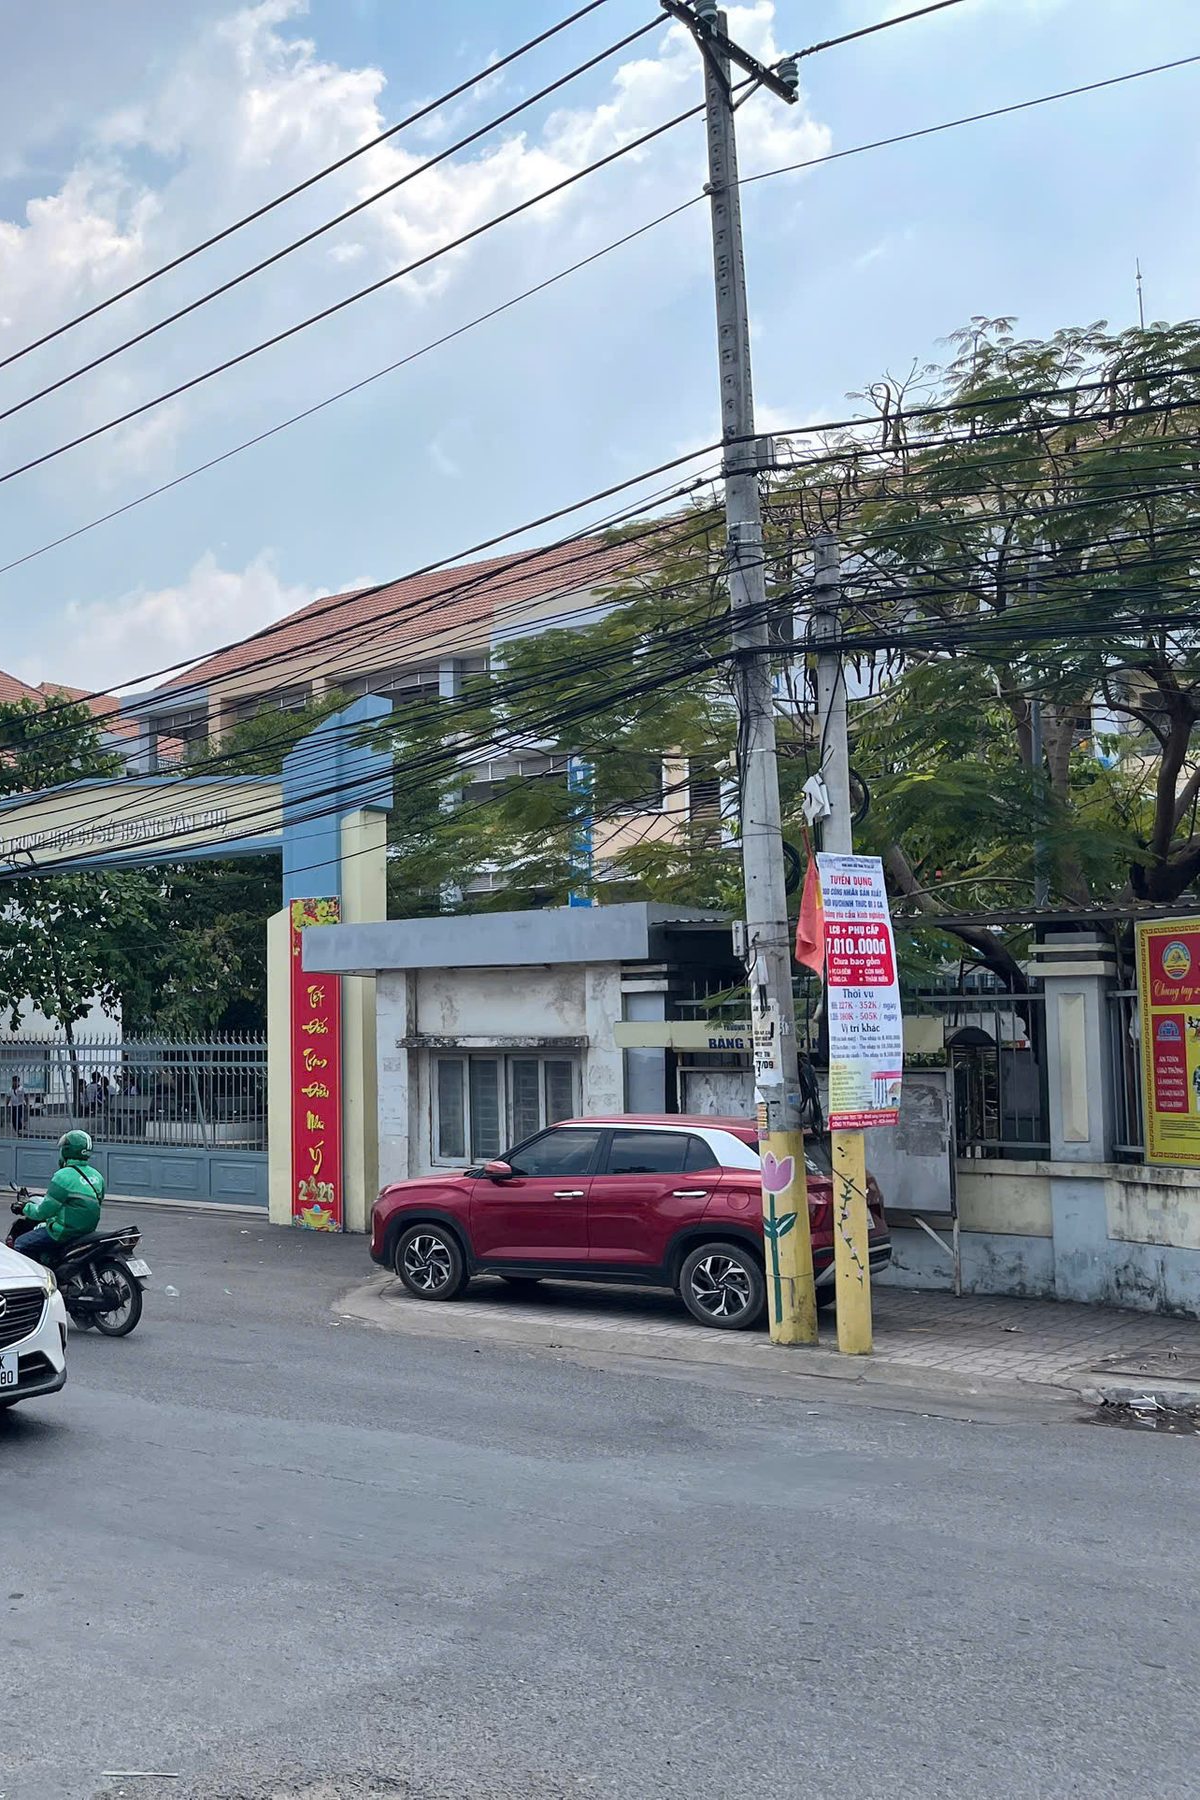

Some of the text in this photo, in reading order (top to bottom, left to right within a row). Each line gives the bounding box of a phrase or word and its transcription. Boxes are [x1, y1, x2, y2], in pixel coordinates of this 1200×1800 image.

[849, 957, 865, 965] bao
[708, 1035, 745, 1049] BẢNG
[308, 1140, 325, 1175] Ý
